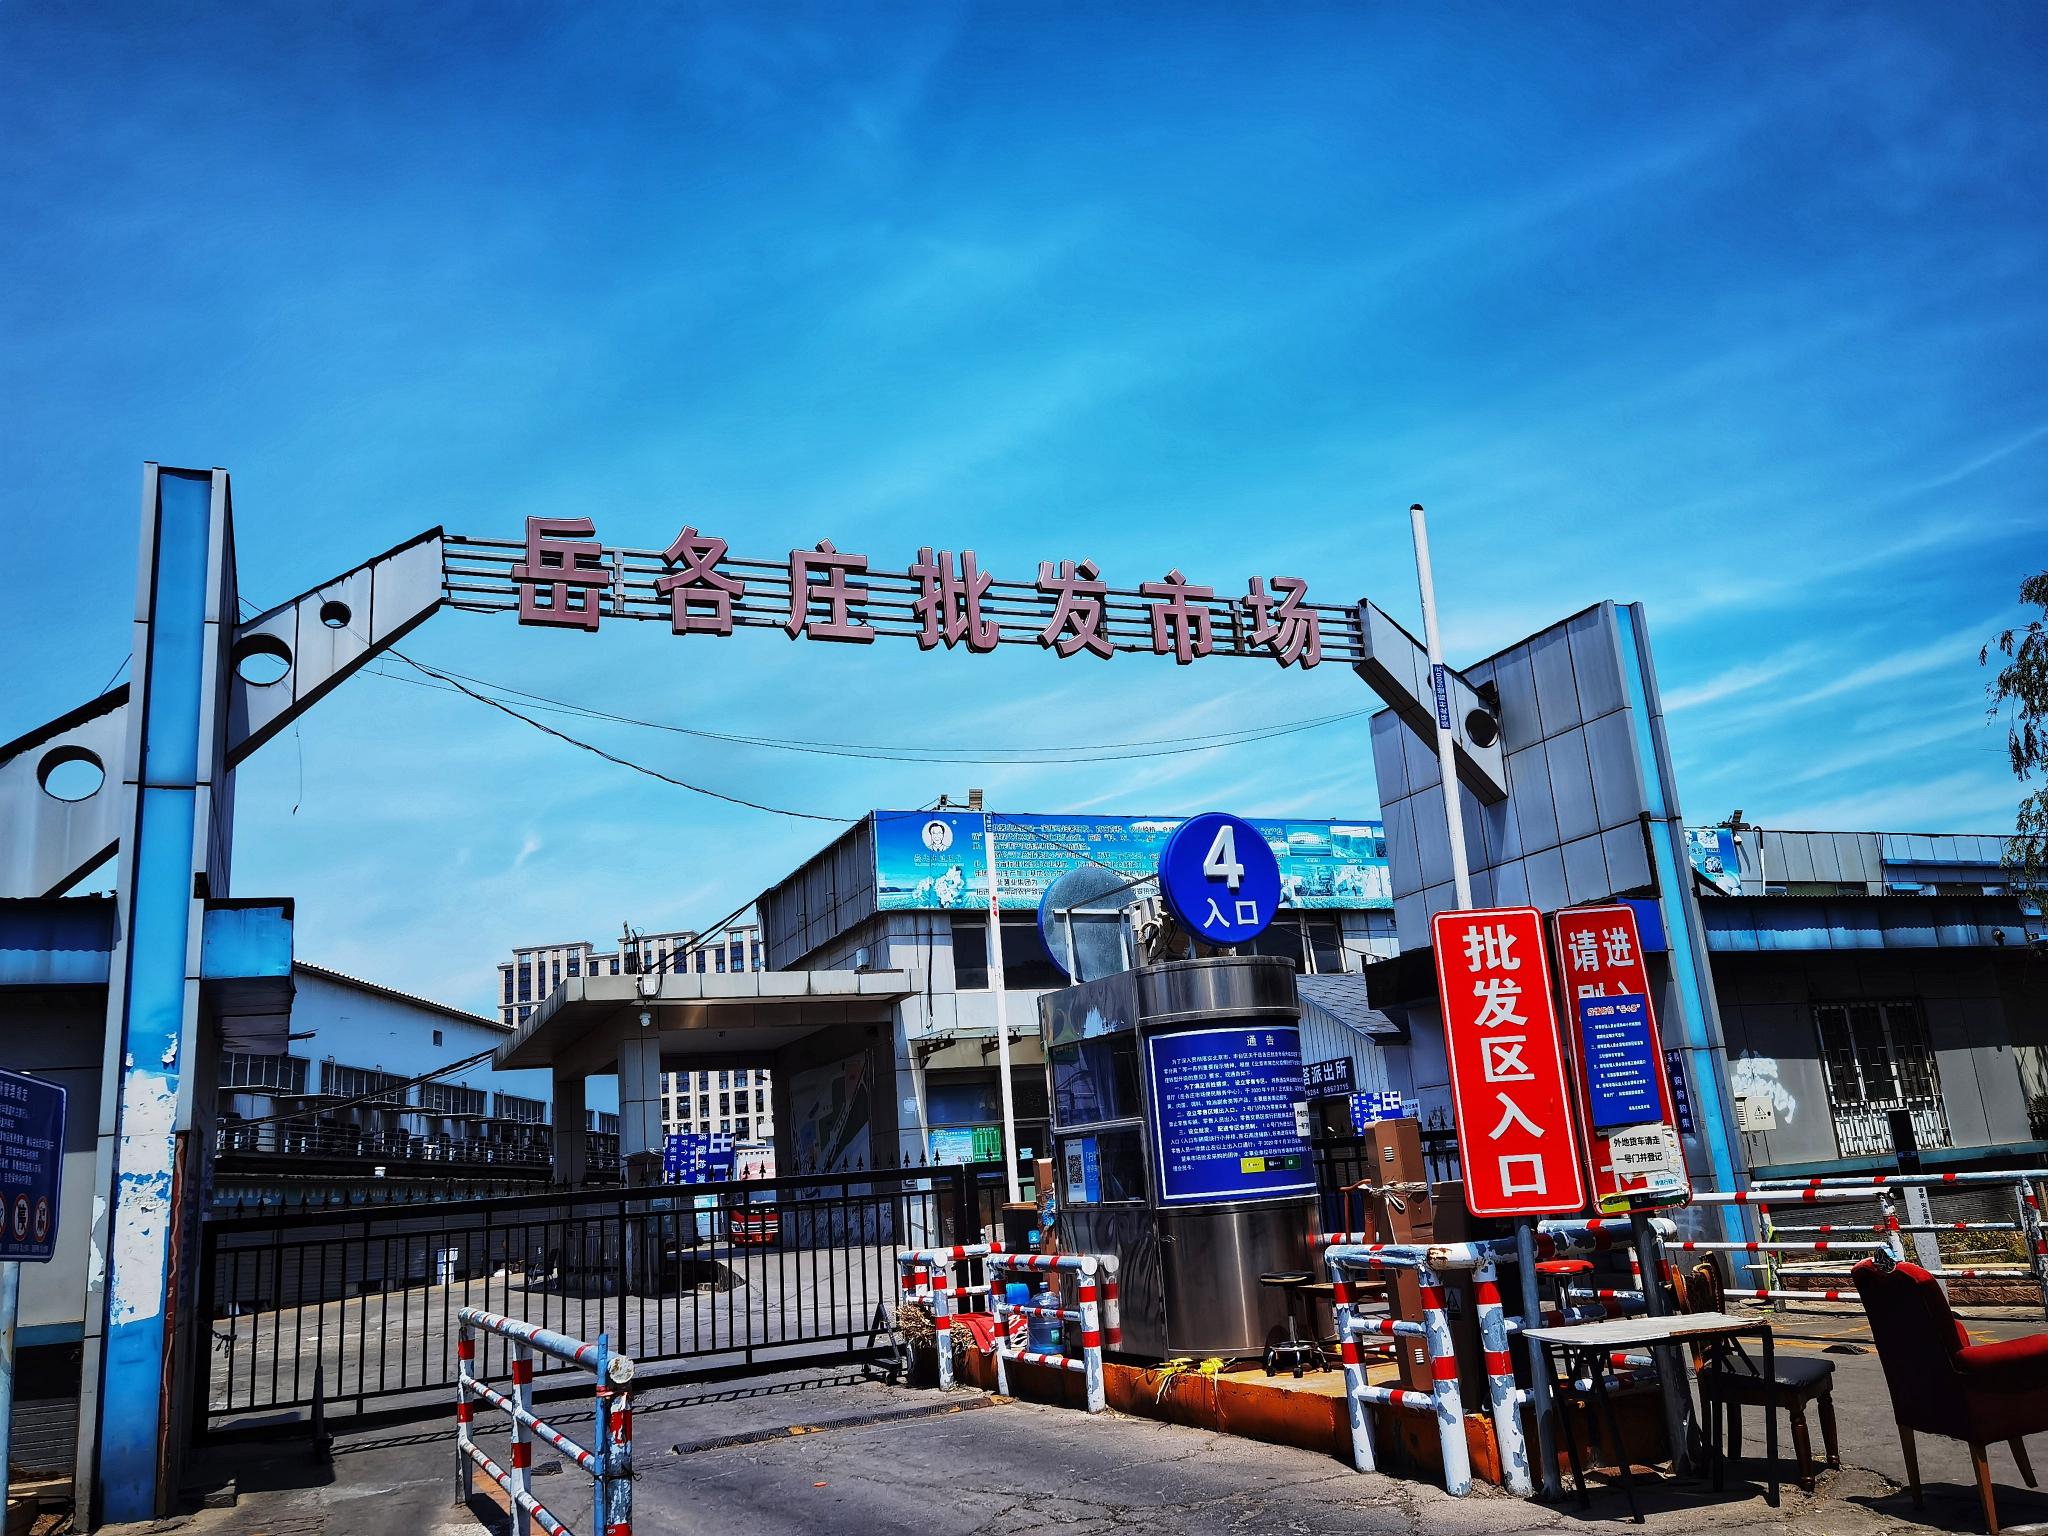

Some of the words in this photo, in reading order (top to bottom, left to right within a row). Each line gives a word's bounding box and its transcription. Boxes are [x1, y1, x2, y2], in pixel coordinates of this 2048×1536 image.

[511, 515, 1322, 670] 岳各庄批发市场
[1203, 825, 1245, 888] 4
[1203, 897, 1259, 928] 入口
[1246, 1035, 1275, 1046] 通告
[1462, 924, 1548, 1197] 批发区入口
[1613, 1135, 1661, 1147] 外地货车请走
[1615, 1151, 1663, 1164] 一号门并登记
